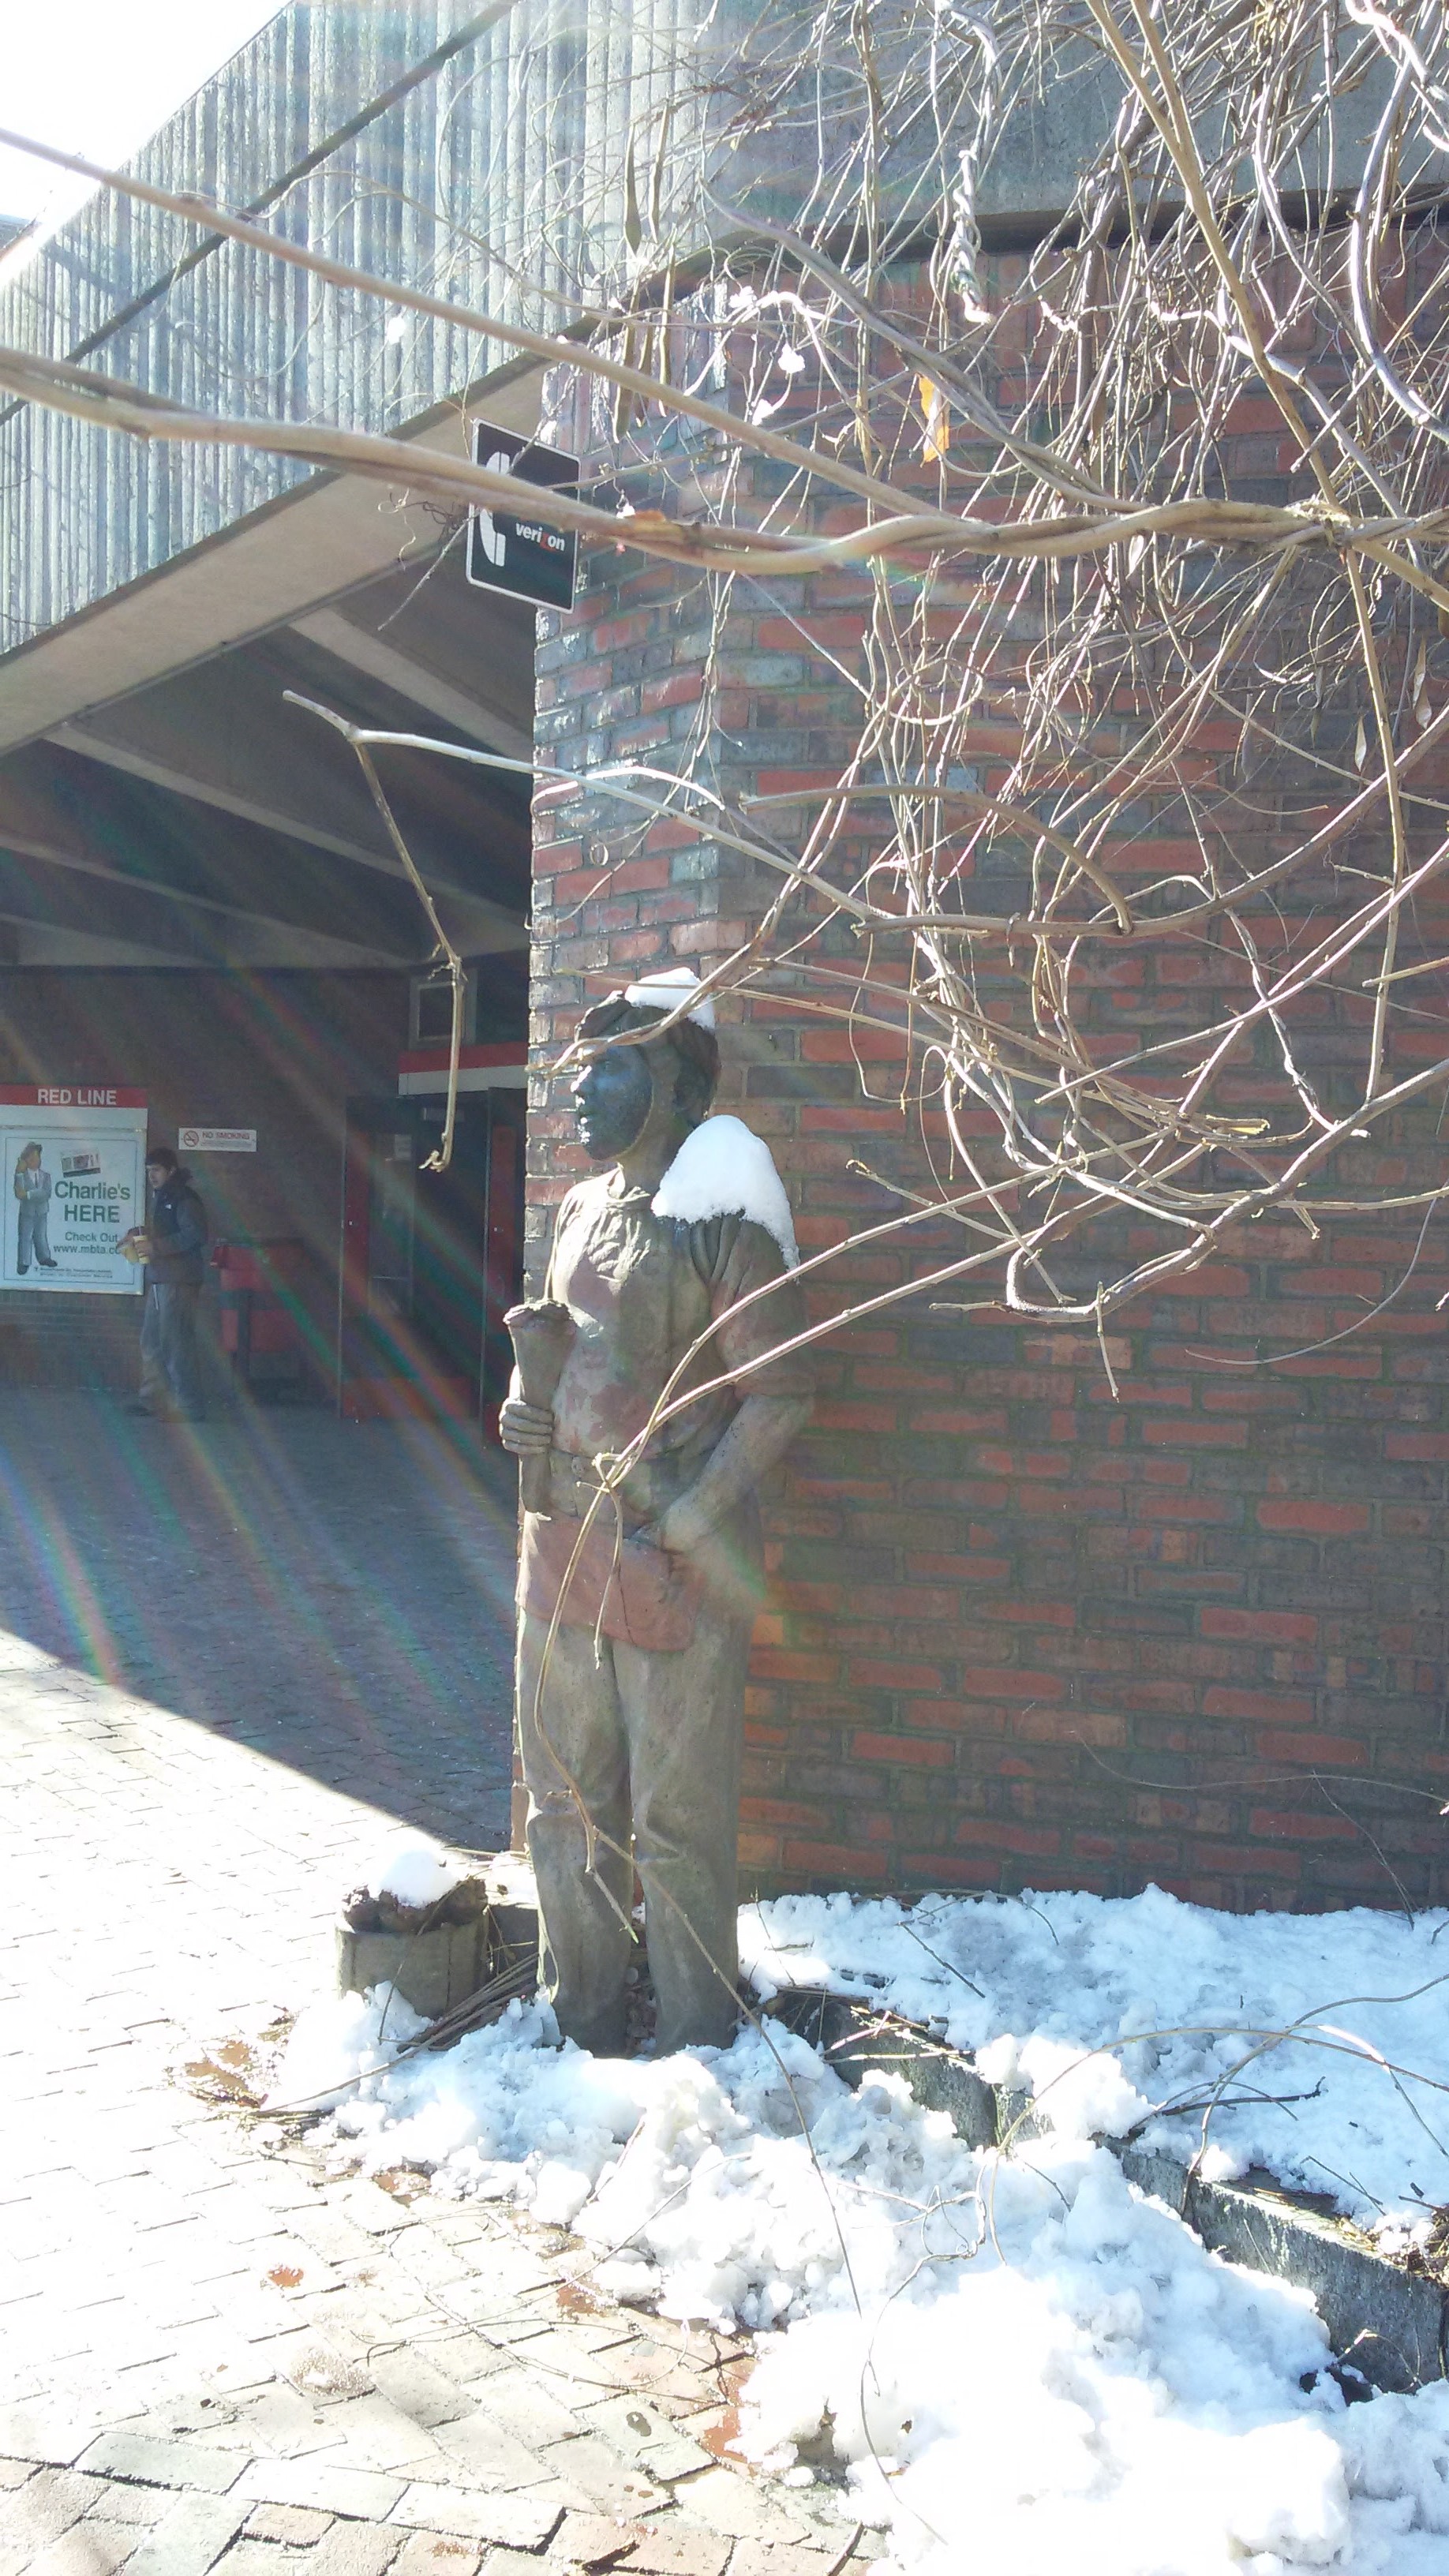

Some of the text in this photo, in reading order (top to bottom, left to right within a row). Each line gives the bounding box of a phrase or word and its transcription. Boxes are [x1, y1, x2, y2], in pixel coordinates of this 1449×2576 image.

[515, 522, 565, 551] verizon
[37, 1089, 117, 1105] RED LINE
[54, 1181, 131, 1200] Charlie's
[64, 1204, 120, 1223] HERE
[65, 1231, 118, 1243] Check Out
